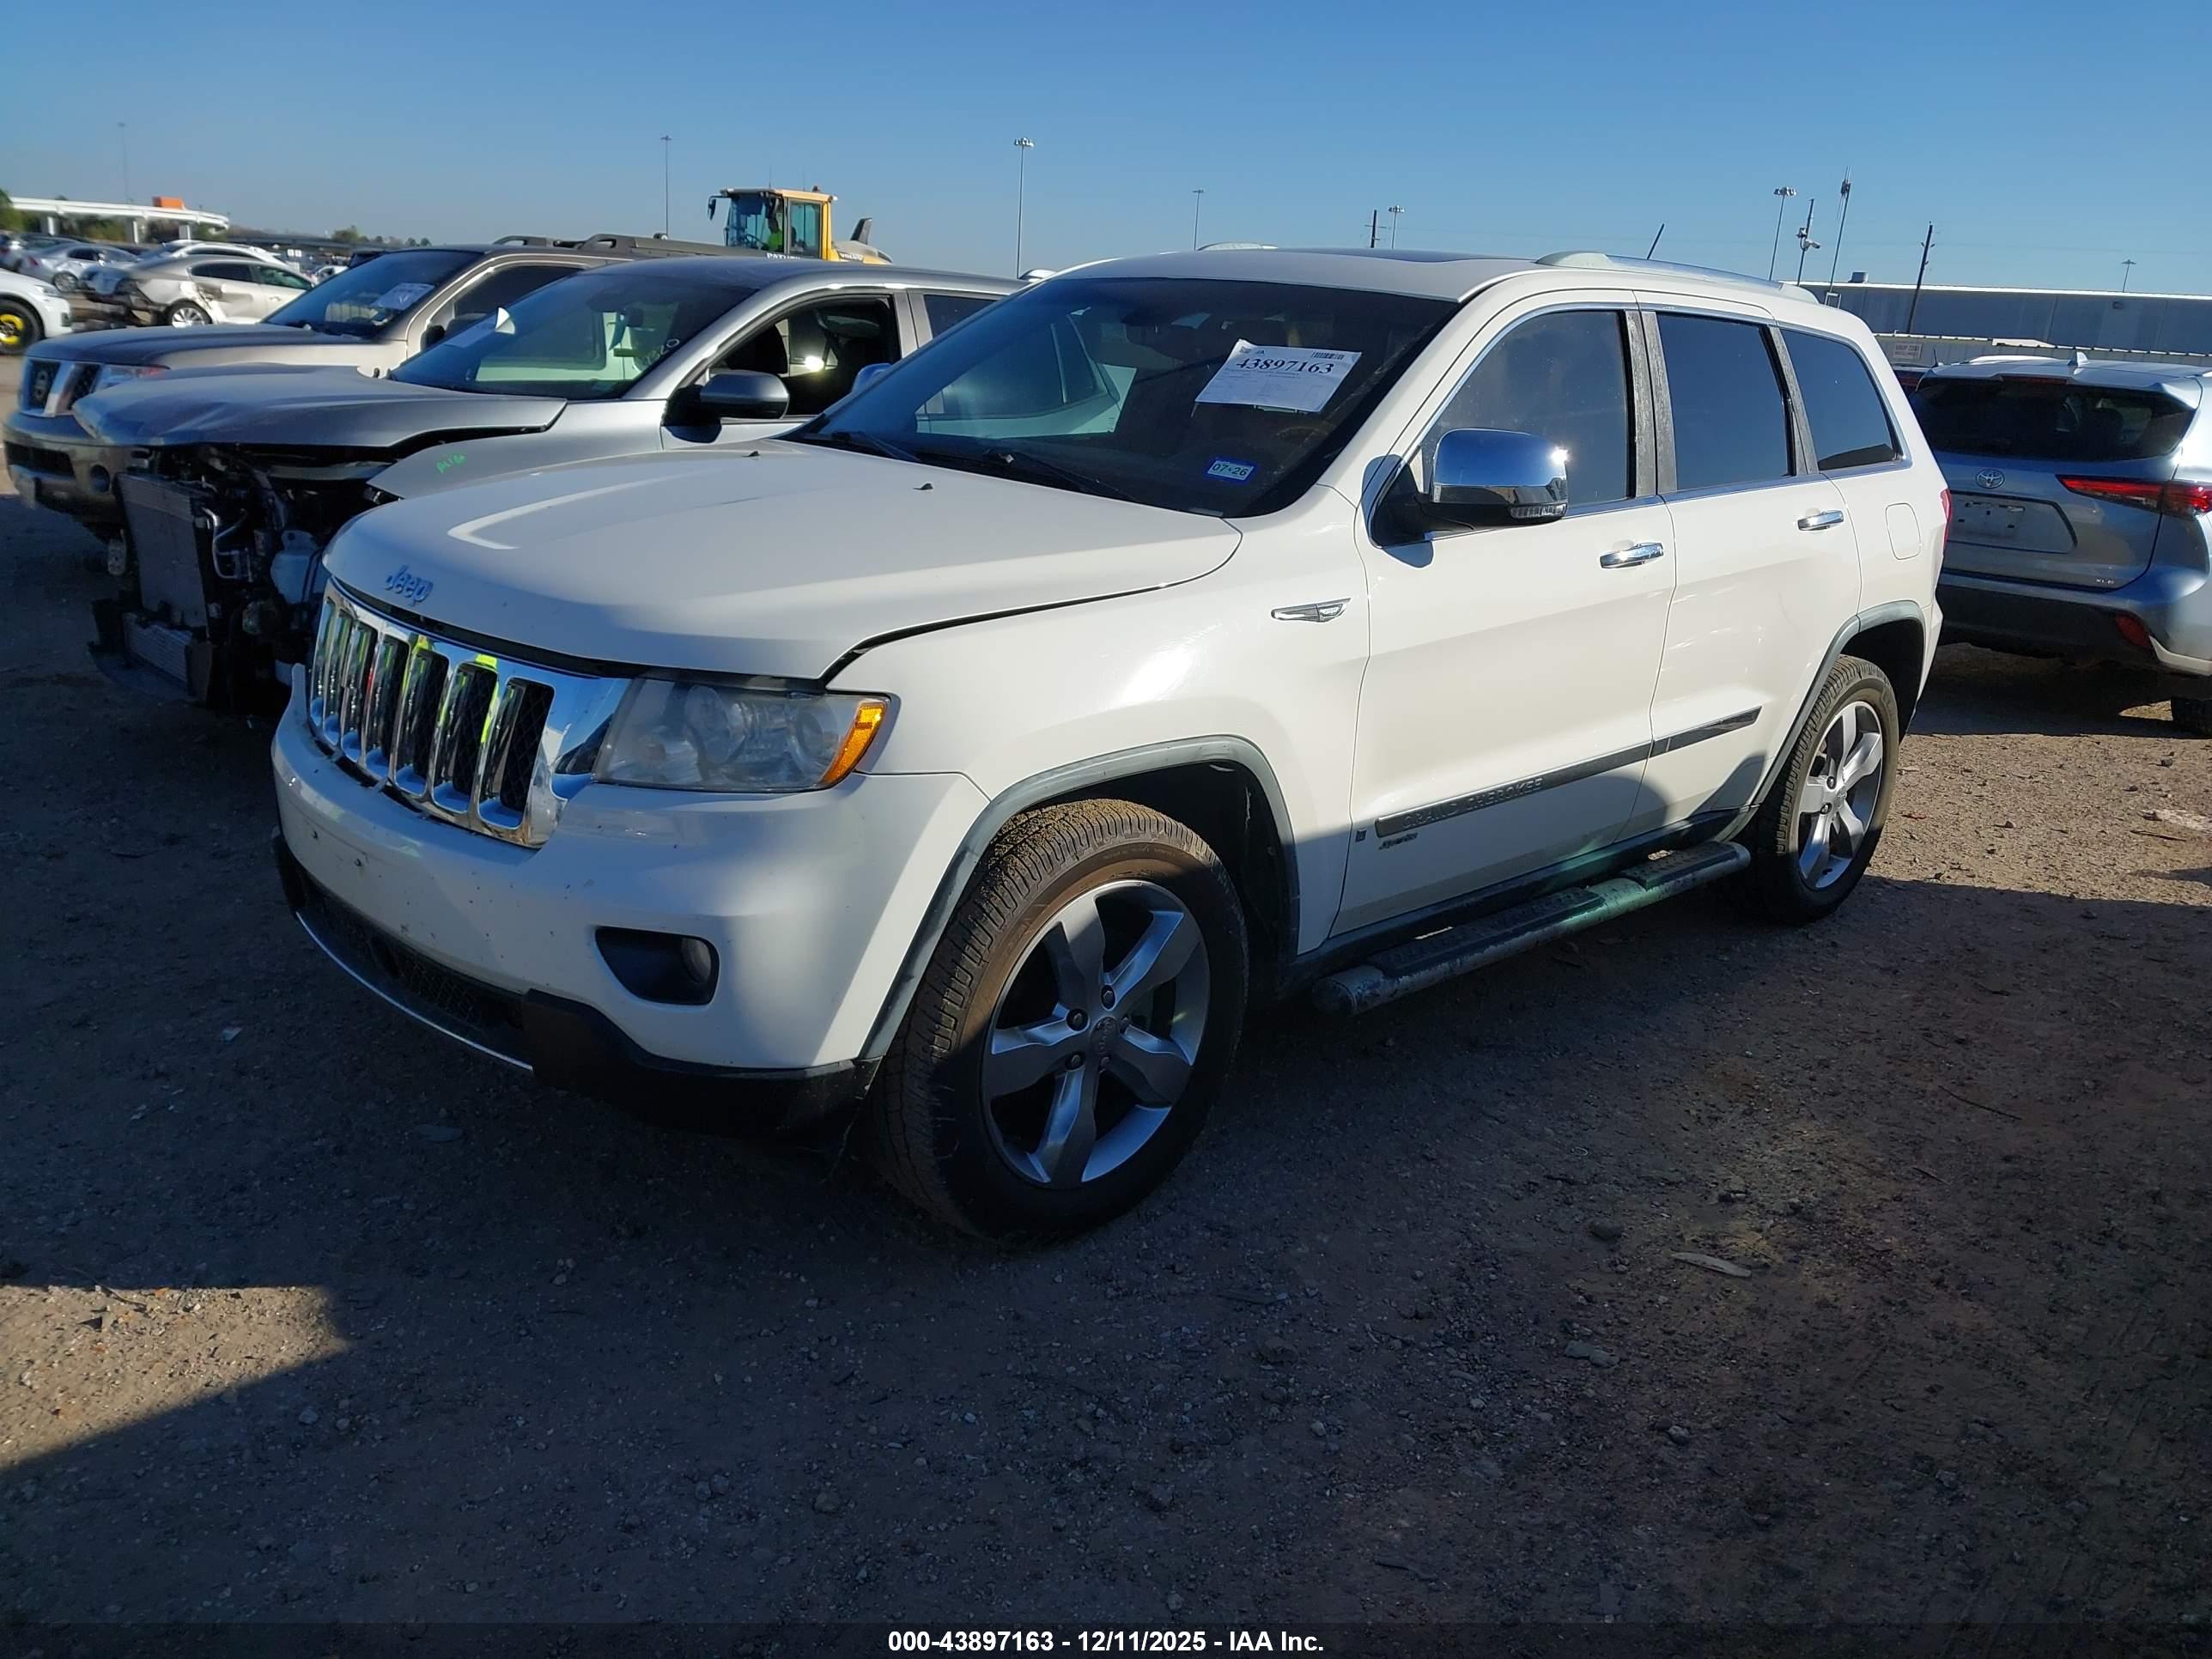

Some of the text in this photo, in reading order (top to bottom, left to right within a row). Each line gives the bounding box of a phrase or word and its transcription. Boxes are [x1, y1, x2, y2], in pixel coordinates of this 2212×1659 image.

[1236, 358, 1334, 374] 43897163
[386, 564, 434, 607] Jeep
[1465, 776, 1543, 811] CHEROKEE
